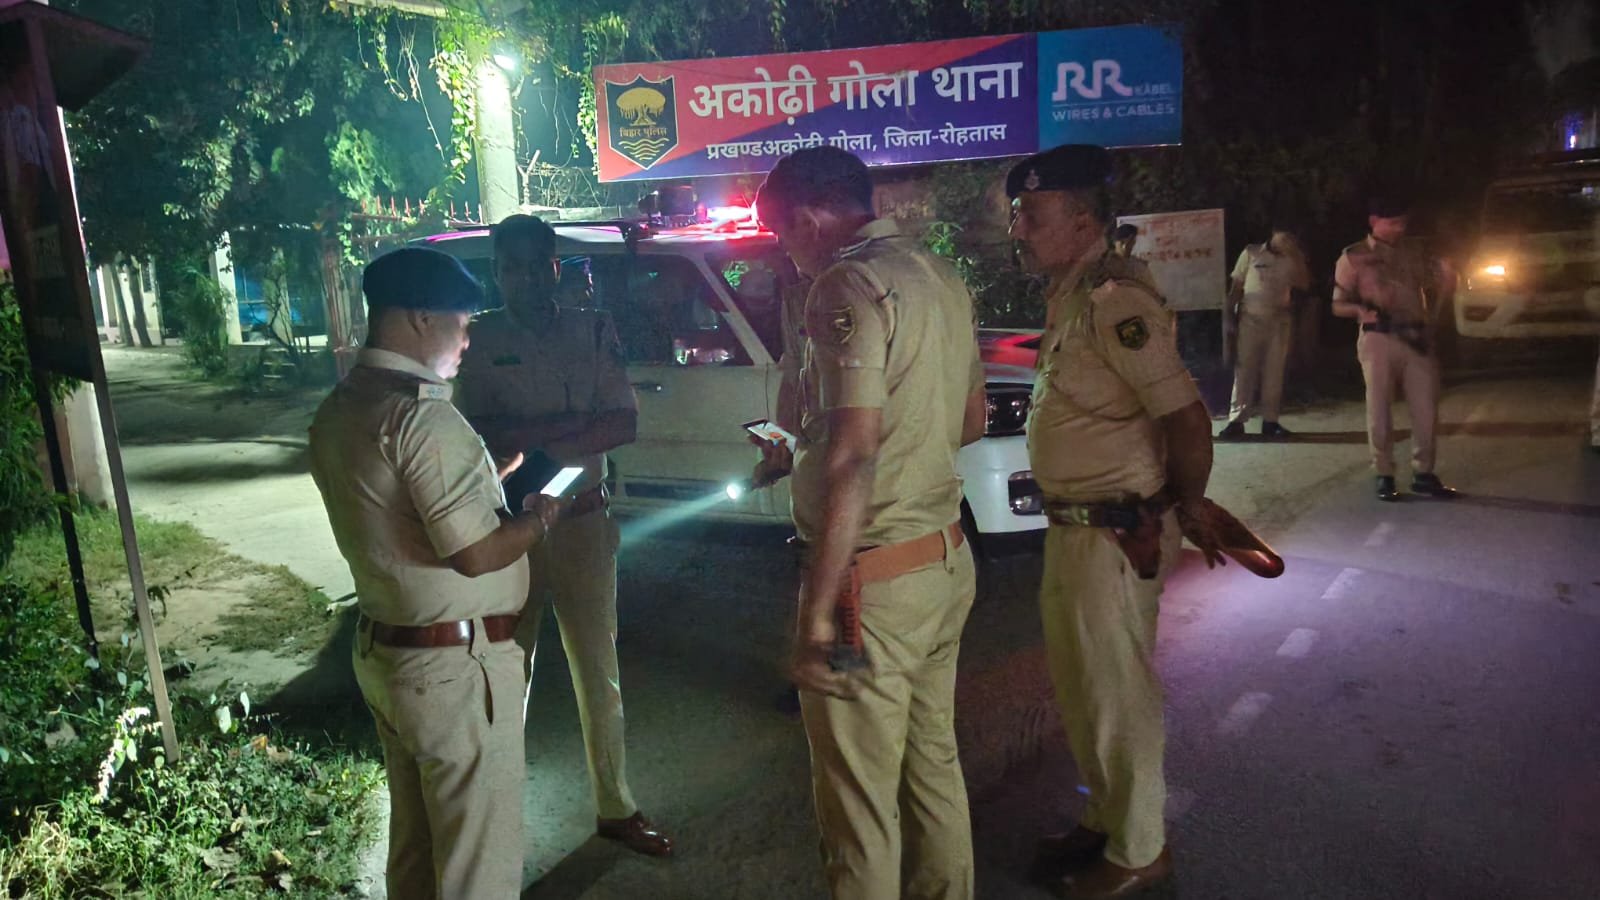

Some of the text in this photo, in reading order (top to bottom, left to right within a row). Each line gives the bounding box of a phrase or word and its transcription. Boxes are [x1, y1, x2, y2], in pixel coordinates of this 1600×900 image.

[689, 60, 1024, 126] अकोढ़ी गोला थाना
[1051, 59, 1133, 102] RR
[1052, 103, 1176, 121] WIRES & CABLES
[883, 122, 1008, 149] जिला-रोहतास
